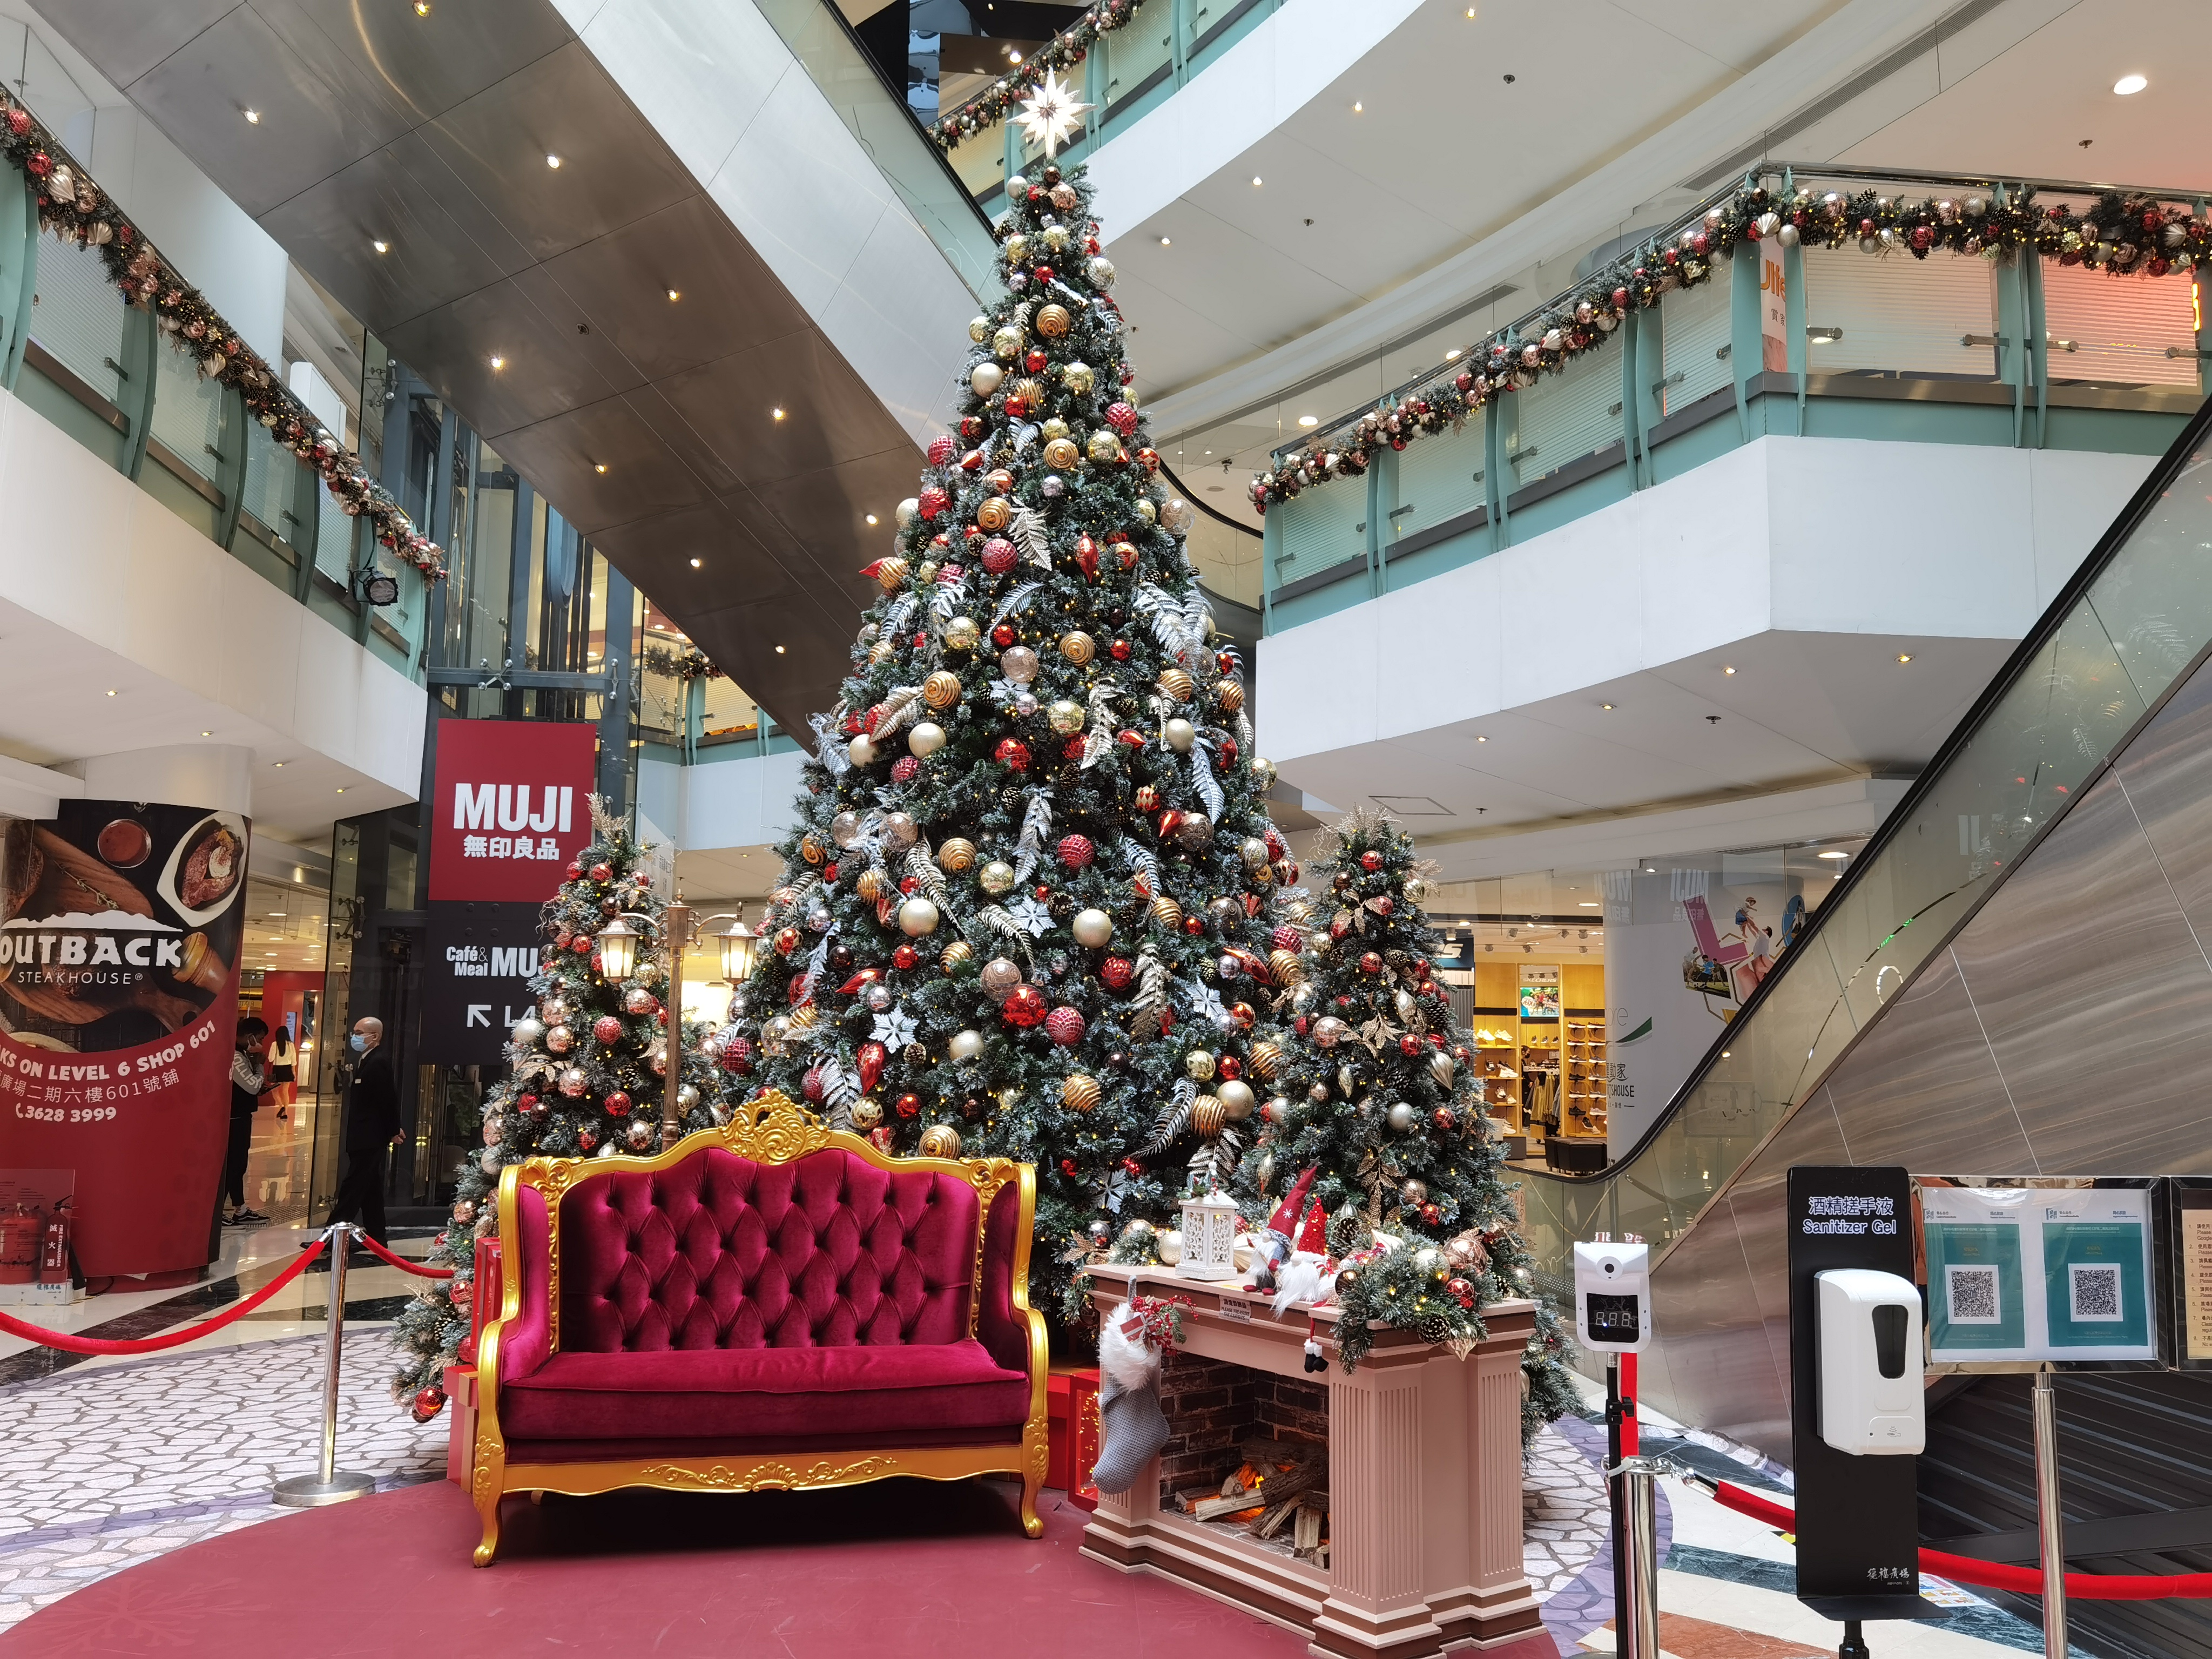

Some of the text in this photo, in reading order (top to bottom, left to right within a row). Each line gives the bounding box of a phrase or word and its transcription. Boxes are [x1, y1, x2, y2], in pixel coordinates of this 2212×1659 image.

[454, 783, 572, 832] MUJI
[463, 834, 559, 860] 無印良品
[0, 935, 182, 967] OUTBACK
[491, 947, 543, 977] MU
[454, 962, 488, 976] Meal
[0, 1020, 215, 1081] KS ON LEVEL 6 SHOP 601
[0, 1068, 179, 1103] 廣場二期六樓601號舖
[25, 1106, 117, 1122] 3628 3999
[1809, 1196, 1894, 1216] 酒精搓手液
[1803, 1219, 1897, 1234] Sanitizer Gel
